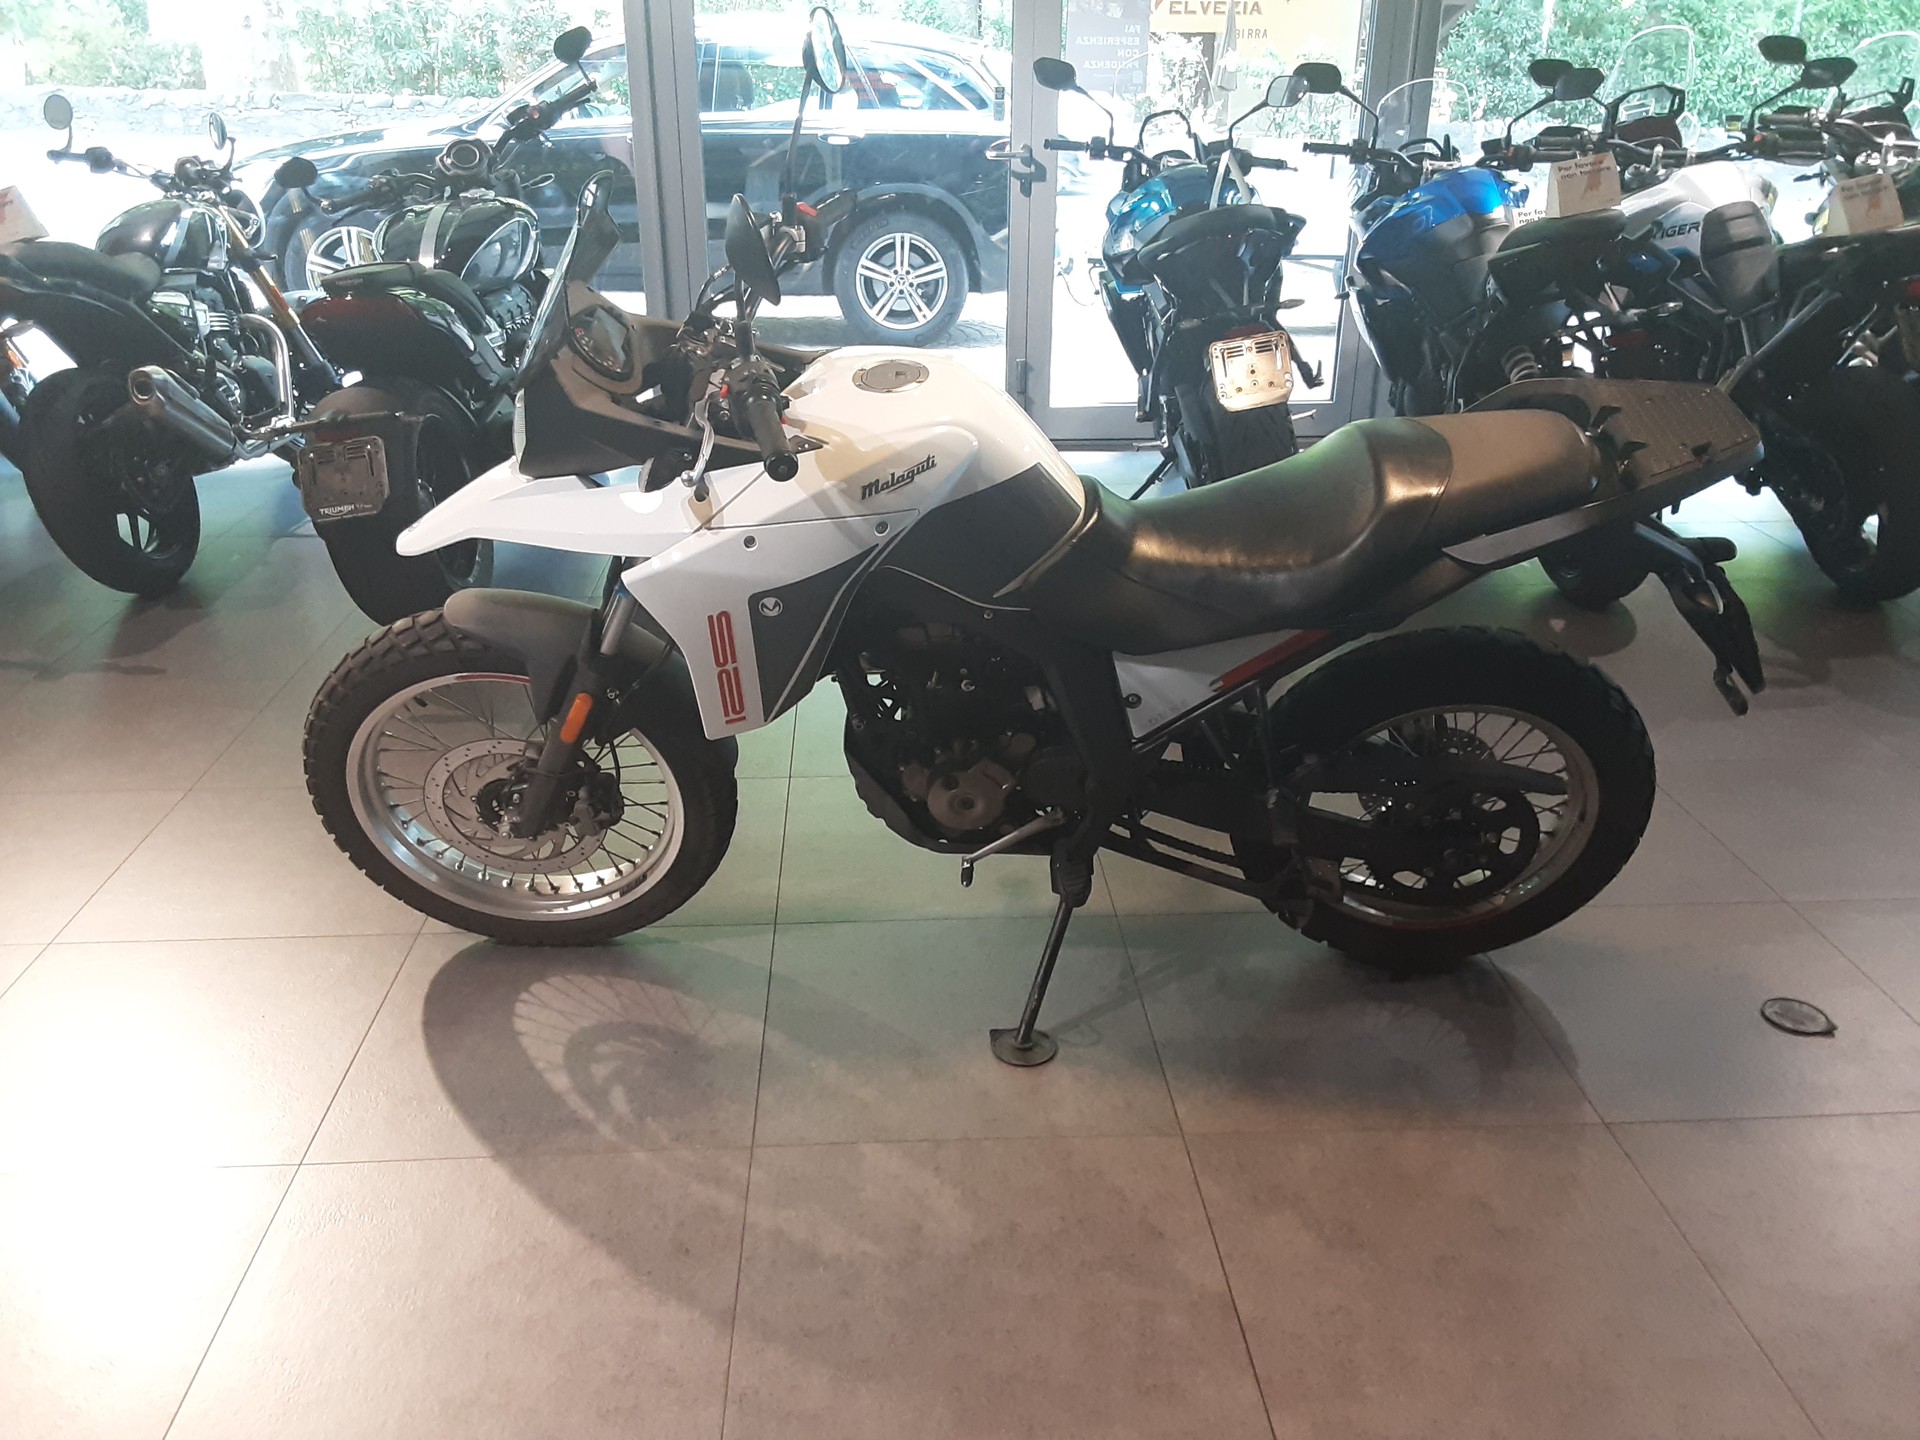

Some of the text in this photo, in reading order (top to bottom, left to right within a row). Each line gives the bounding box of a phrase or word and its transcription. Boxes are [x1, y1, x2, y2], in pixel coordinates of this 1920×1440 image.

[861, 454, 937, 500] Malaguti
[319, 504, 355, 516] TRIUMPH
[707, 610, 746, 724] 125
